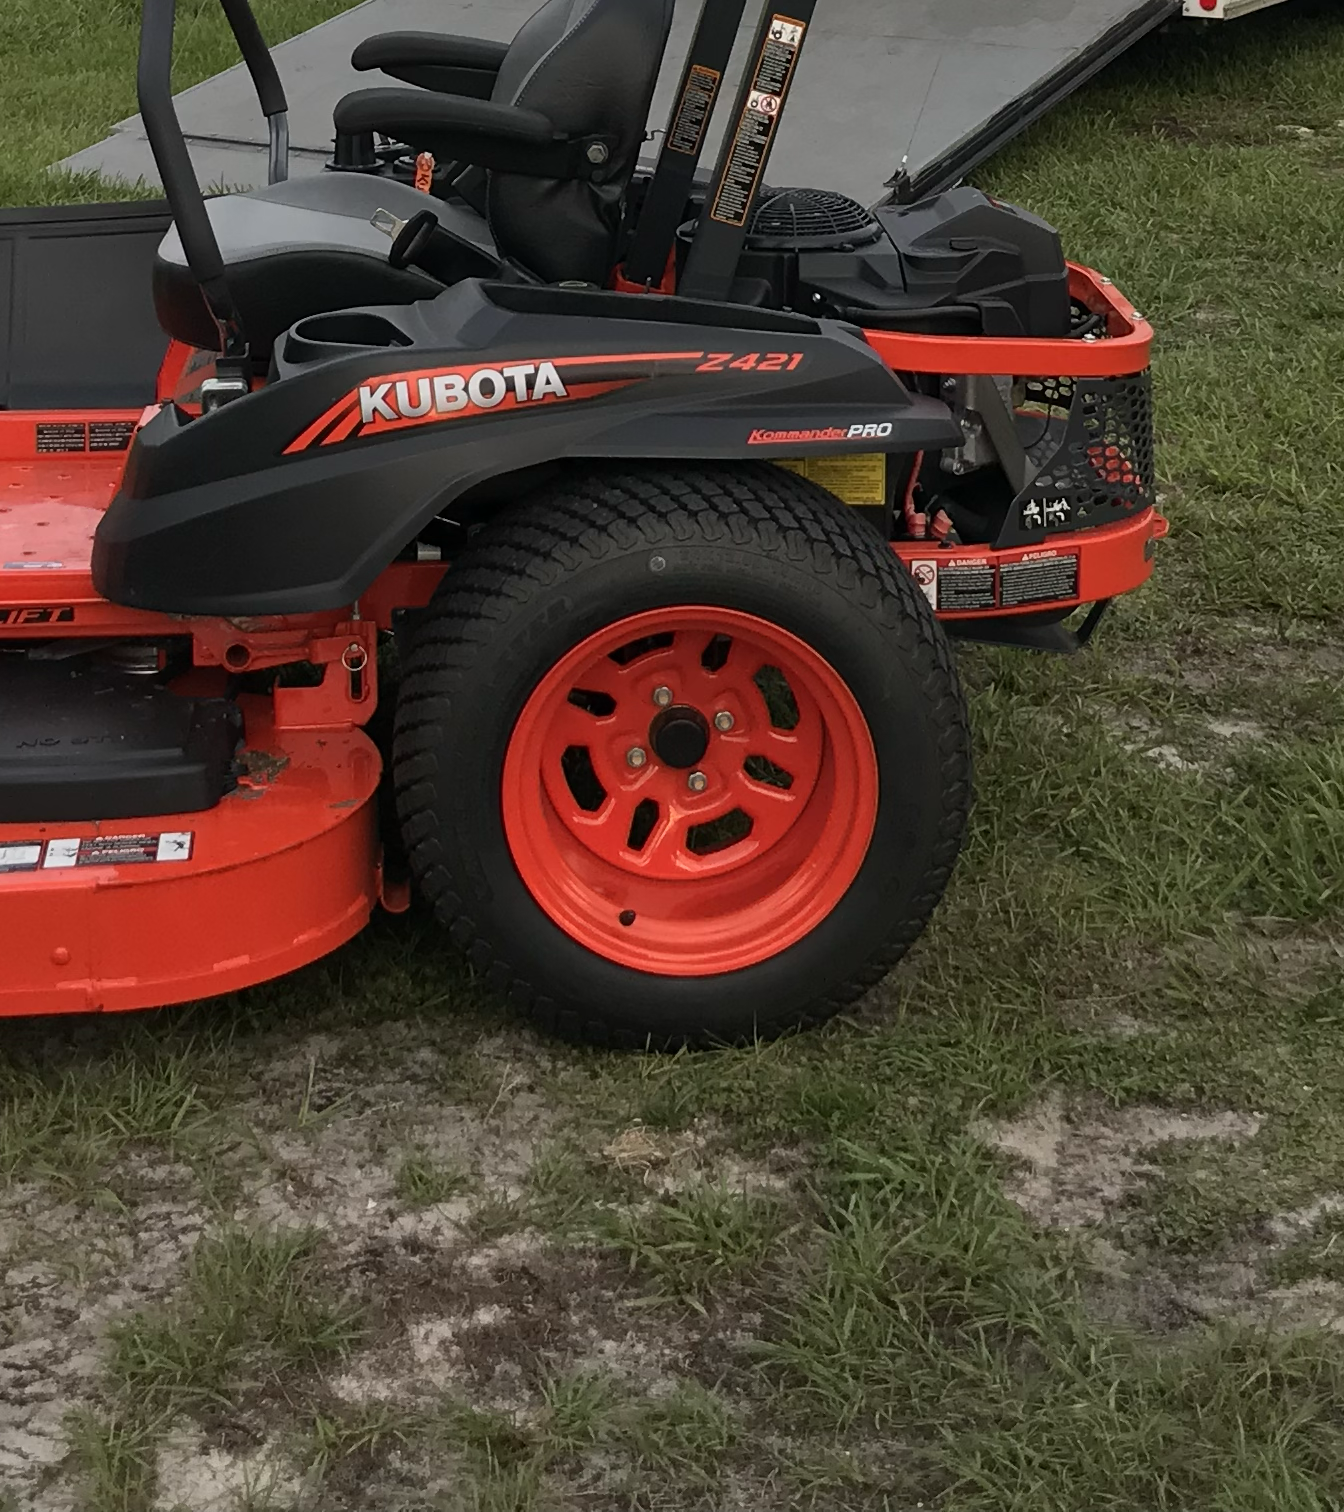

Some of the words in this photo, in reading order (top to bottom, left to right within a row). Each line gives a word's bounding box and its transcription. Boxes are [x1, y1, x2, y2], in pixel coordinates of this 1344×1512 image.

[696, 352, 804, 373] Z421
[359, 361, 567, 423] KUBOTA
[956, 558, 987, 566] DANGER
